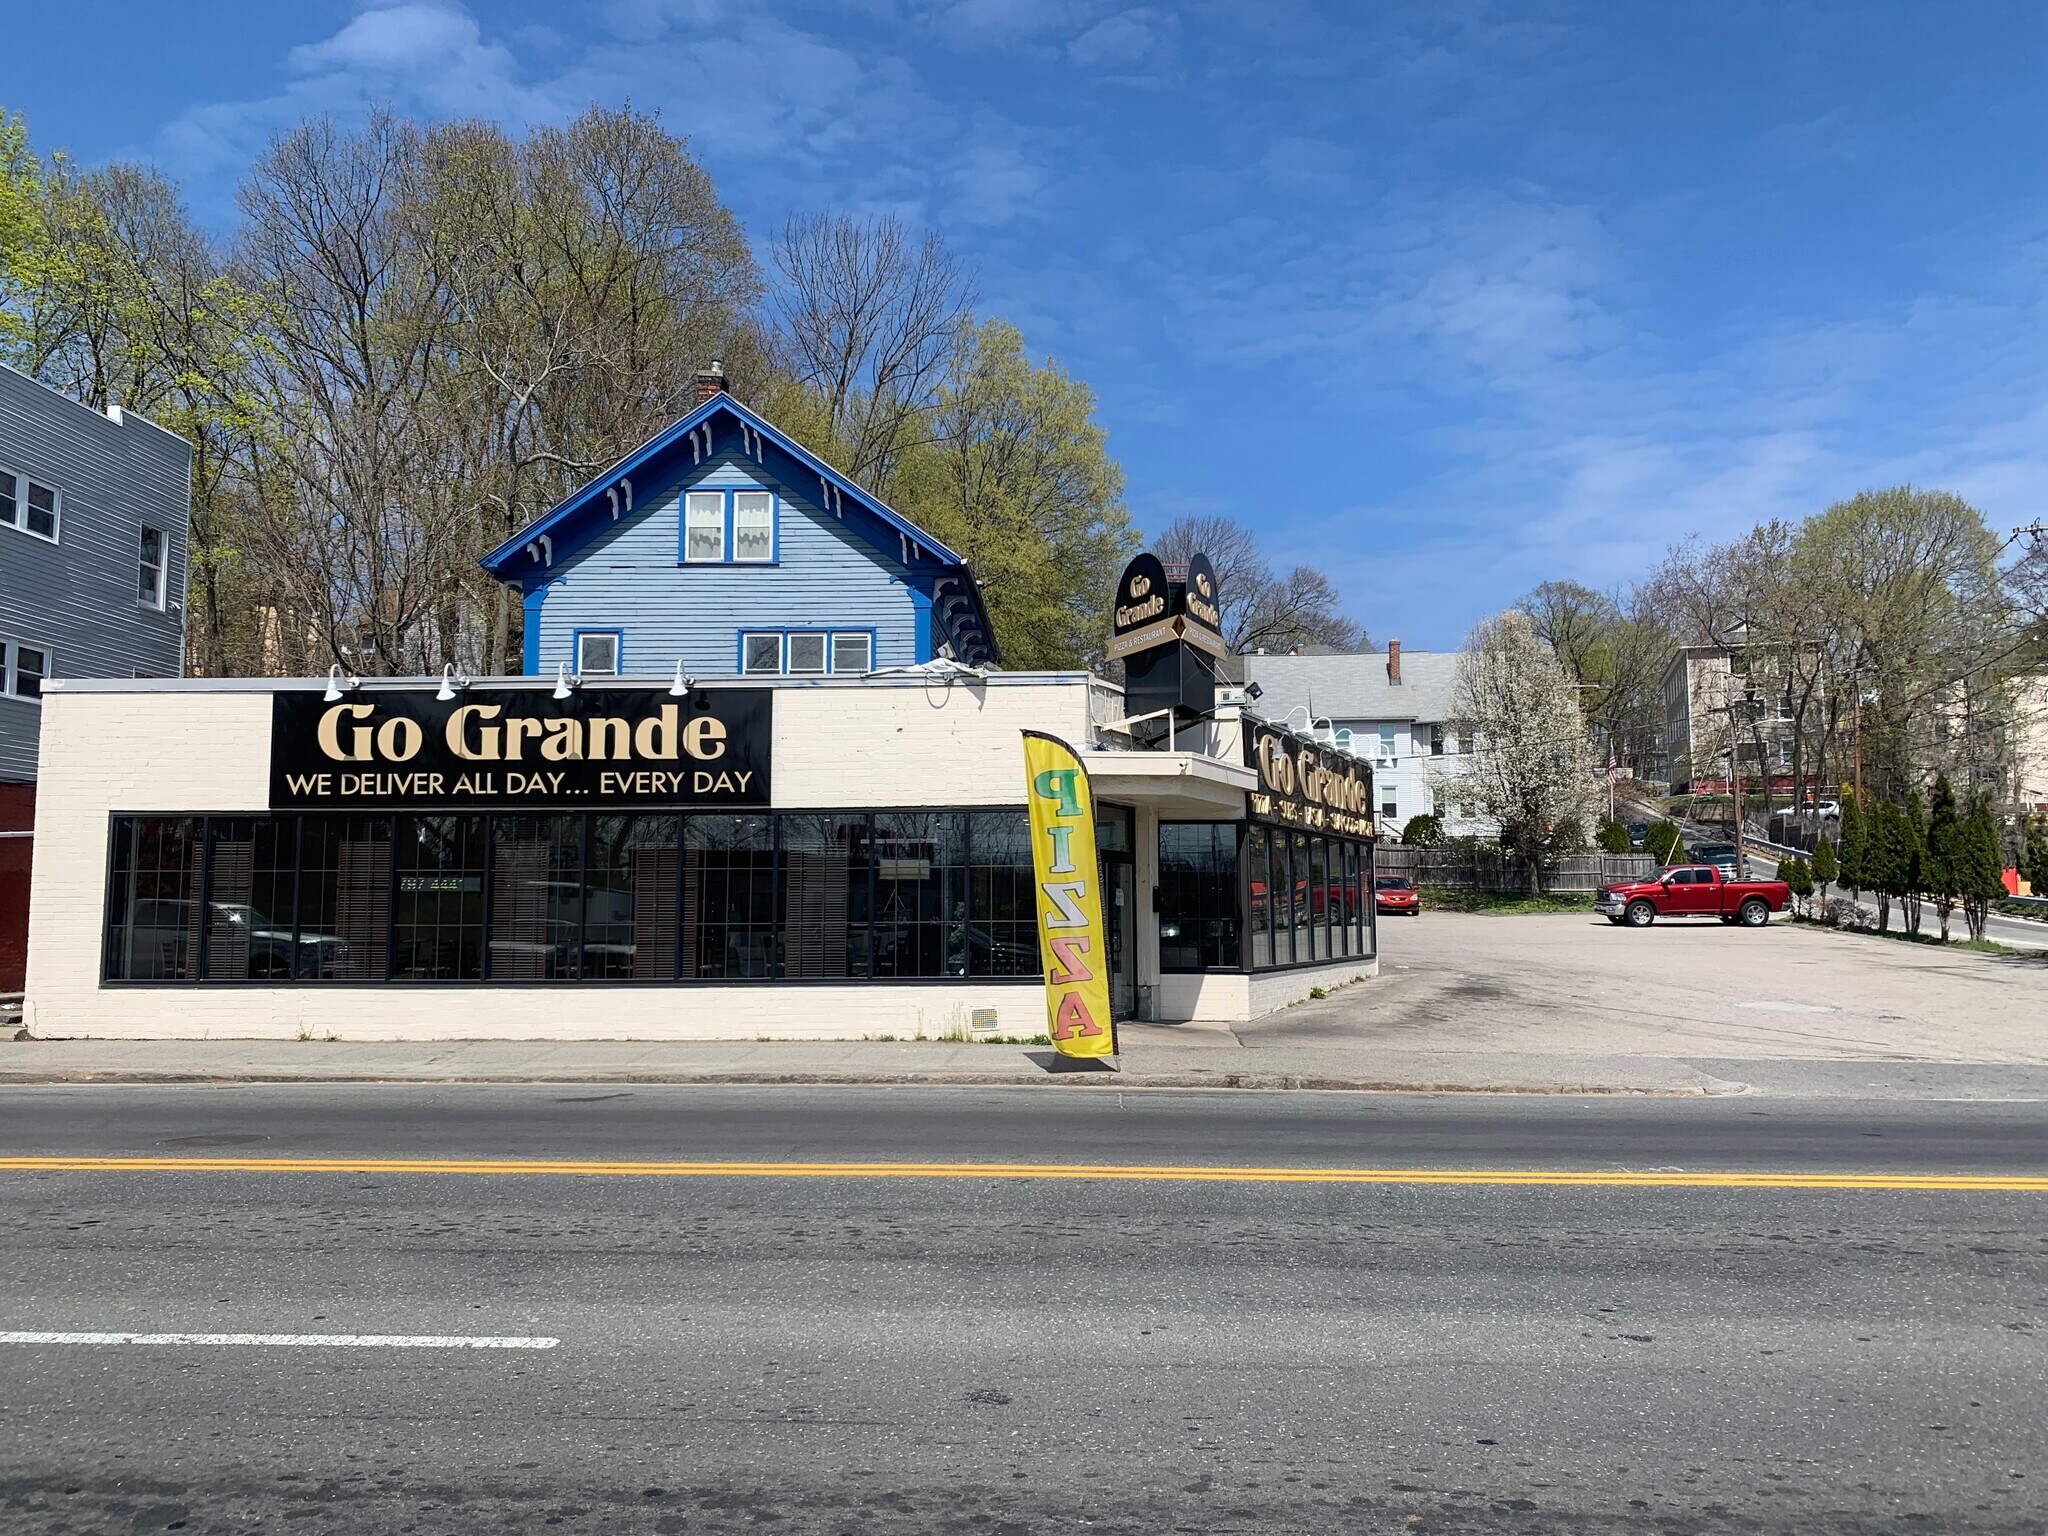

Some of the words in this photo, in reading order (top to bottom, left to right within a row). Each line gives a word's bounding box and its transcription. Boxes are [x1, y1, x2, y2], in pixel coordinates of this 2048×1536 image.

[1130, 574, 1151, 598] Go
[1196, 573, 1211, 599] Go
[1116, 594, 1165, 628] Grande
[1186, 592, 1219, 627] Grande
[1113, 640, 1128, 651] PIZZA
[1133, 627, 1166, 645] RESTAURANT
[317, 703, 423, 762] Go
[445, 703, 727, 762] Grande
[286, 773, 332, 796] WE
[340, 772, 445, 796] DELIVER
[451, 772, 498, 794] ALL
[506, 771, 590, 795] DAY...
[600, 771, 687, 794] EVERY
[694, 770, 753, 793] DAY
[1259, 734, 1295, 796] Go
[1298, 750, 1366, 815] Grande
